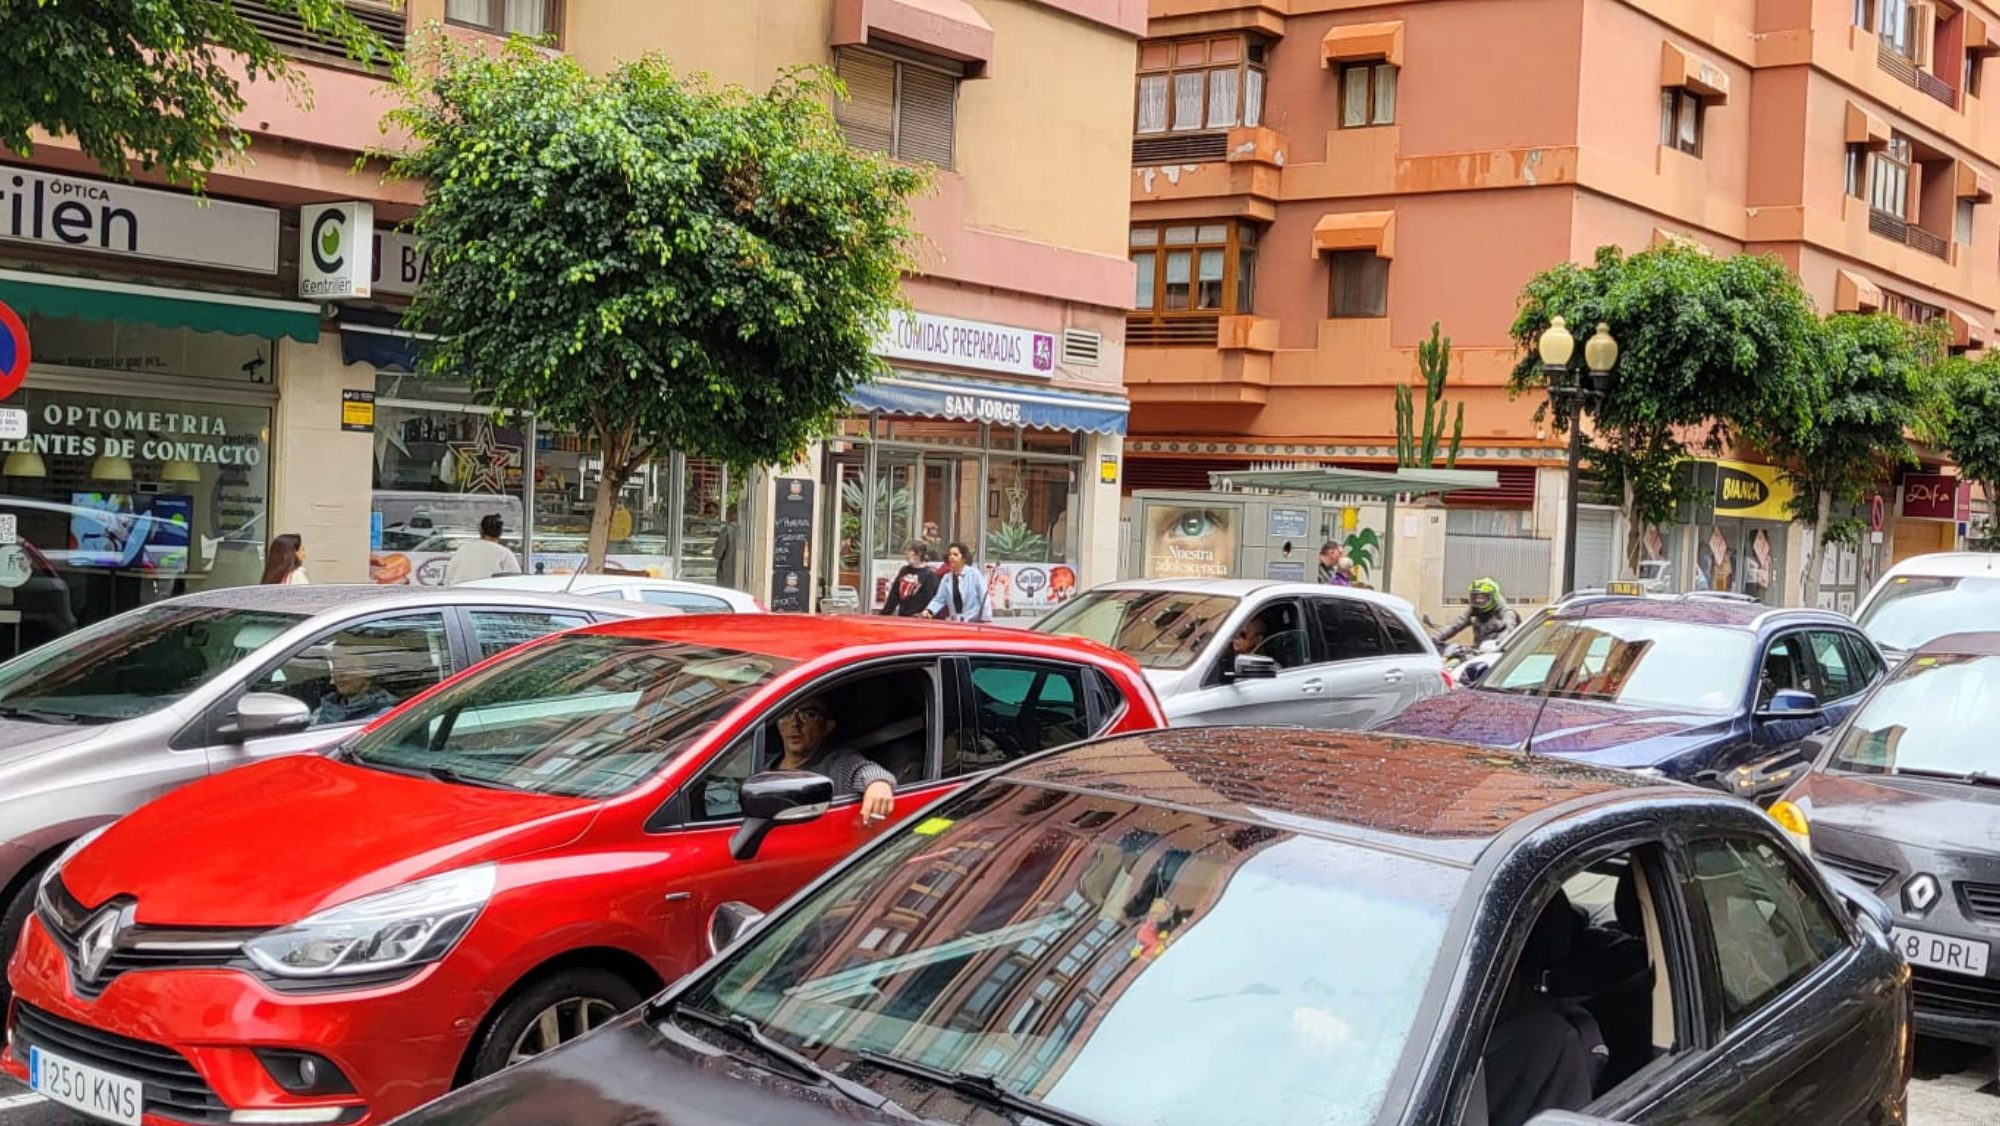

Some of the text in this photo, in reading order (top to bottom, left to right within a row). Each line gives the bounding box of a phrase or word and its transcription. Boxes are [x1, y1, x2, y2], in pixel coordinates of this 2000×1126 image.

[50, 178, 110, 202] ÓPTICA
[897, 319, 1021, 364] COMIDAS PREPARADAS
[43, 404, 226, 435] OPTOMETRIA
[945, 396, 1021, 421] SAN JORGE
[1, 434, 260, 465] LENTES DE CONTACTO
[1723, 478, 1760, 501] BIANCA
[1169, 544, 1214, 561] Nuestra
[1154, 558, 1228, 576] adolescencia
[1613, 583, 1631, 595] TAXI
[1930, 938, 1979, 971] DRL
[43, 1057, 136, 1118] 1250 KNS
